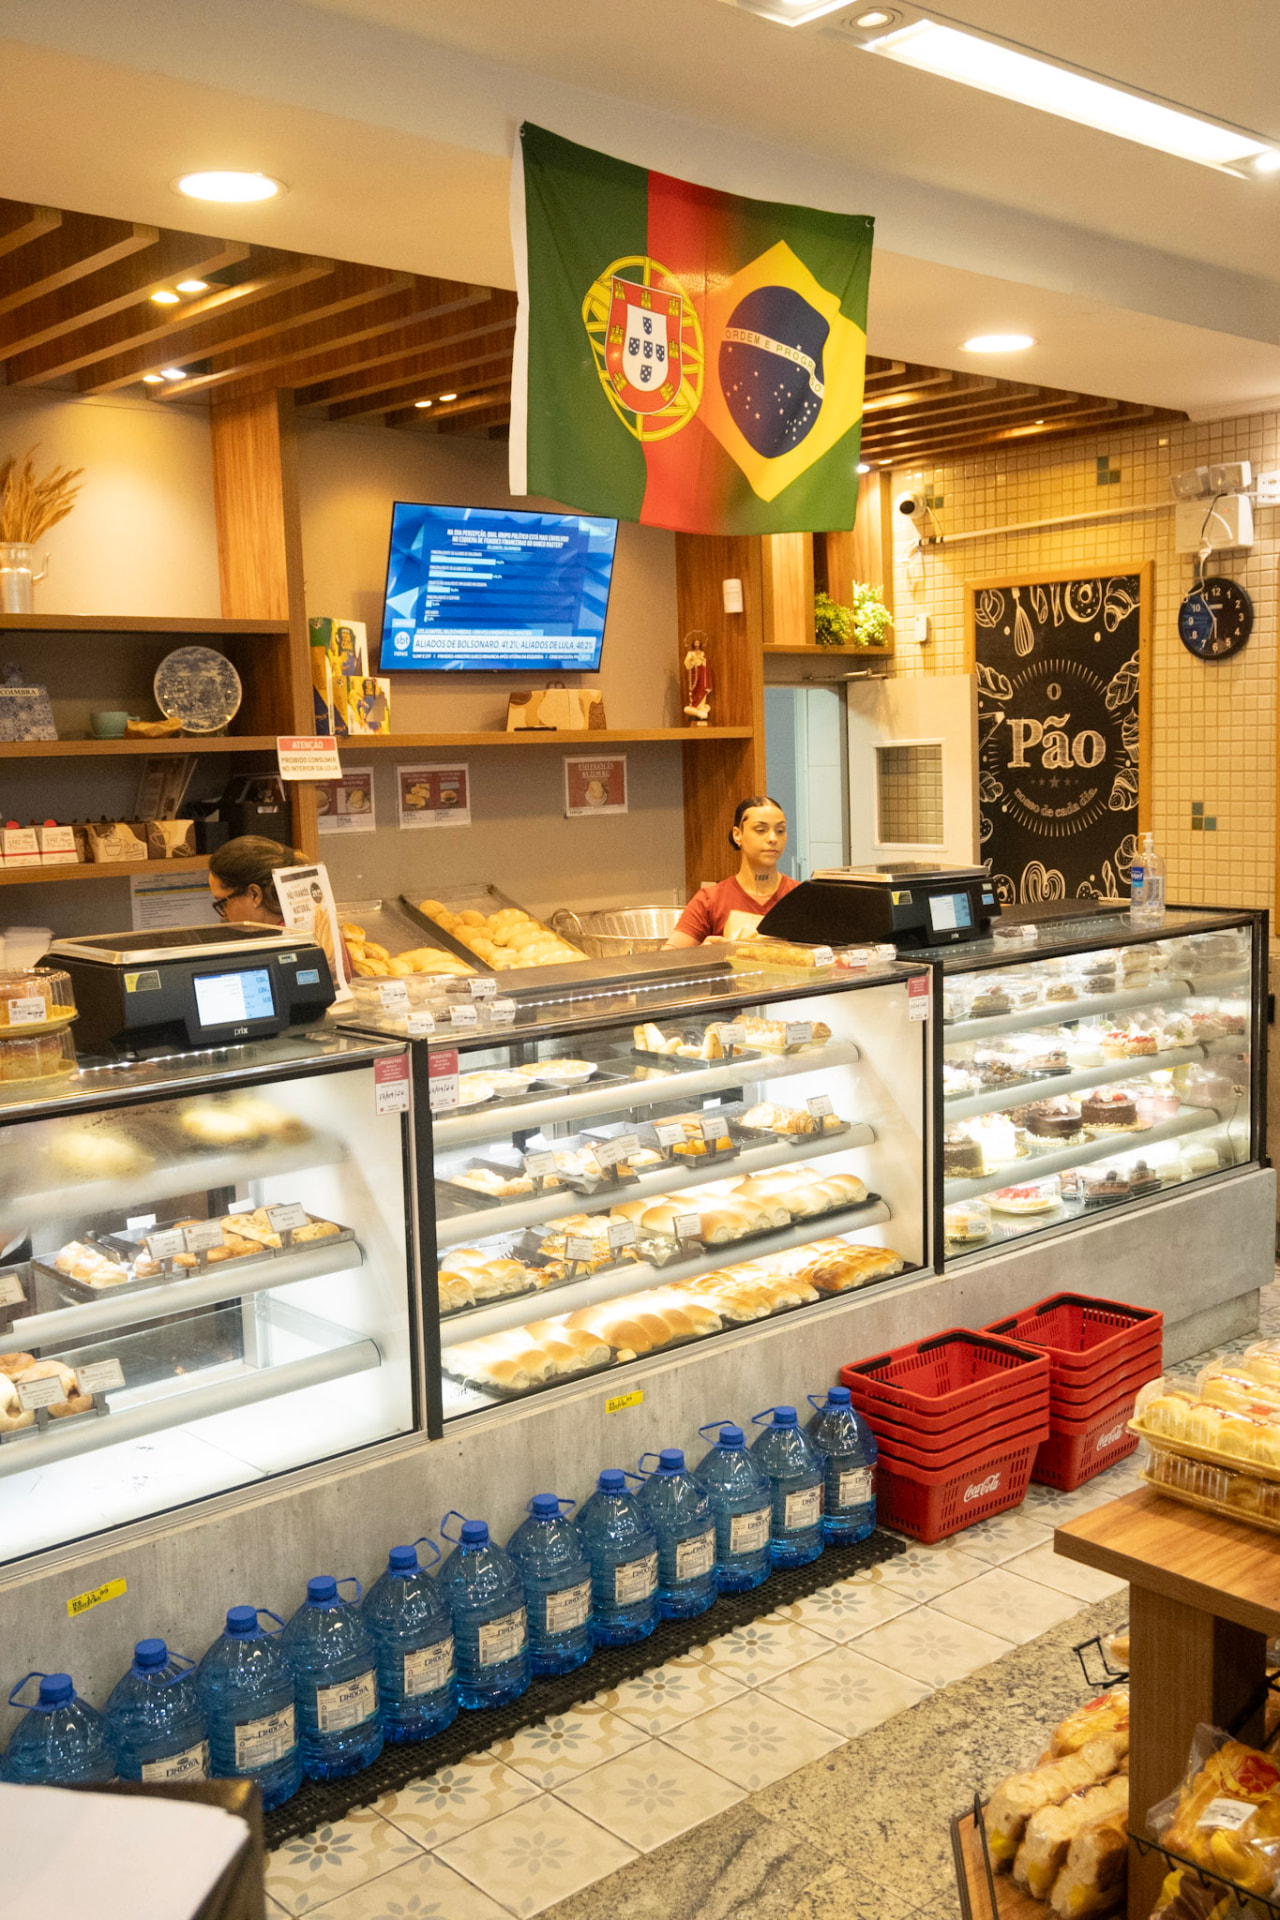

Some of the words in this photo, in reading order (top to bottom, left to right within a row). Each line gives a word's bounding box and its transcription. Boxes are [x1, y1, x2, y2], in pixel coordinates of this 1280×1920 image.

[725, 329, 760, 345] ORDEM
[764, 339, 771, 349] E
[776, 343, 822, 393] PROGRSO
[1211, 587, 1221, 596] 12
[1226, 590, 1231, 599] 1
[1191, 604, 1201, 613] 10
[1235, 600, 1241, 609] 2
[1188, 616, 1194, 626] 9
[1238, 612, 1244, 622] 3
[1192, 630, 1198, 640] 8
[1234, 627, 1240, 636] 4
[395, 635, 409, 646] sbt
[415, 640, 446, 649] ALIADOS
[446, 640, 457, 649] DE
[520, 640, 549, 649] ALIADOS
[549, 640, 558, 649] DE
[1201, 639, 1207, 648] 7
[1225, 637, 1231, 647] 5
[1212, 642, 1218, 652] 6
[1046, 682, 1062, 701] O
[292, 739, 324, 750] ATENÇÃO
[1006, 712, 1107, 770] Pão
[308, 756, 336, 764] CONSUMIR
[1013, 787, 1040, 813] nosso
[1041, 804, 1054, 818] de
[1055, 801, 1081, 818] cada
[234, 1026, 248, 1037] prix
[963, 1472, 1002, 1503] Coca-Cola
[339, 1685, 369, 1703] LINDOYA
[257, 1719, 290, 1738] LINDOYA
[166, 1758, 200, 1777] LINDOYA
